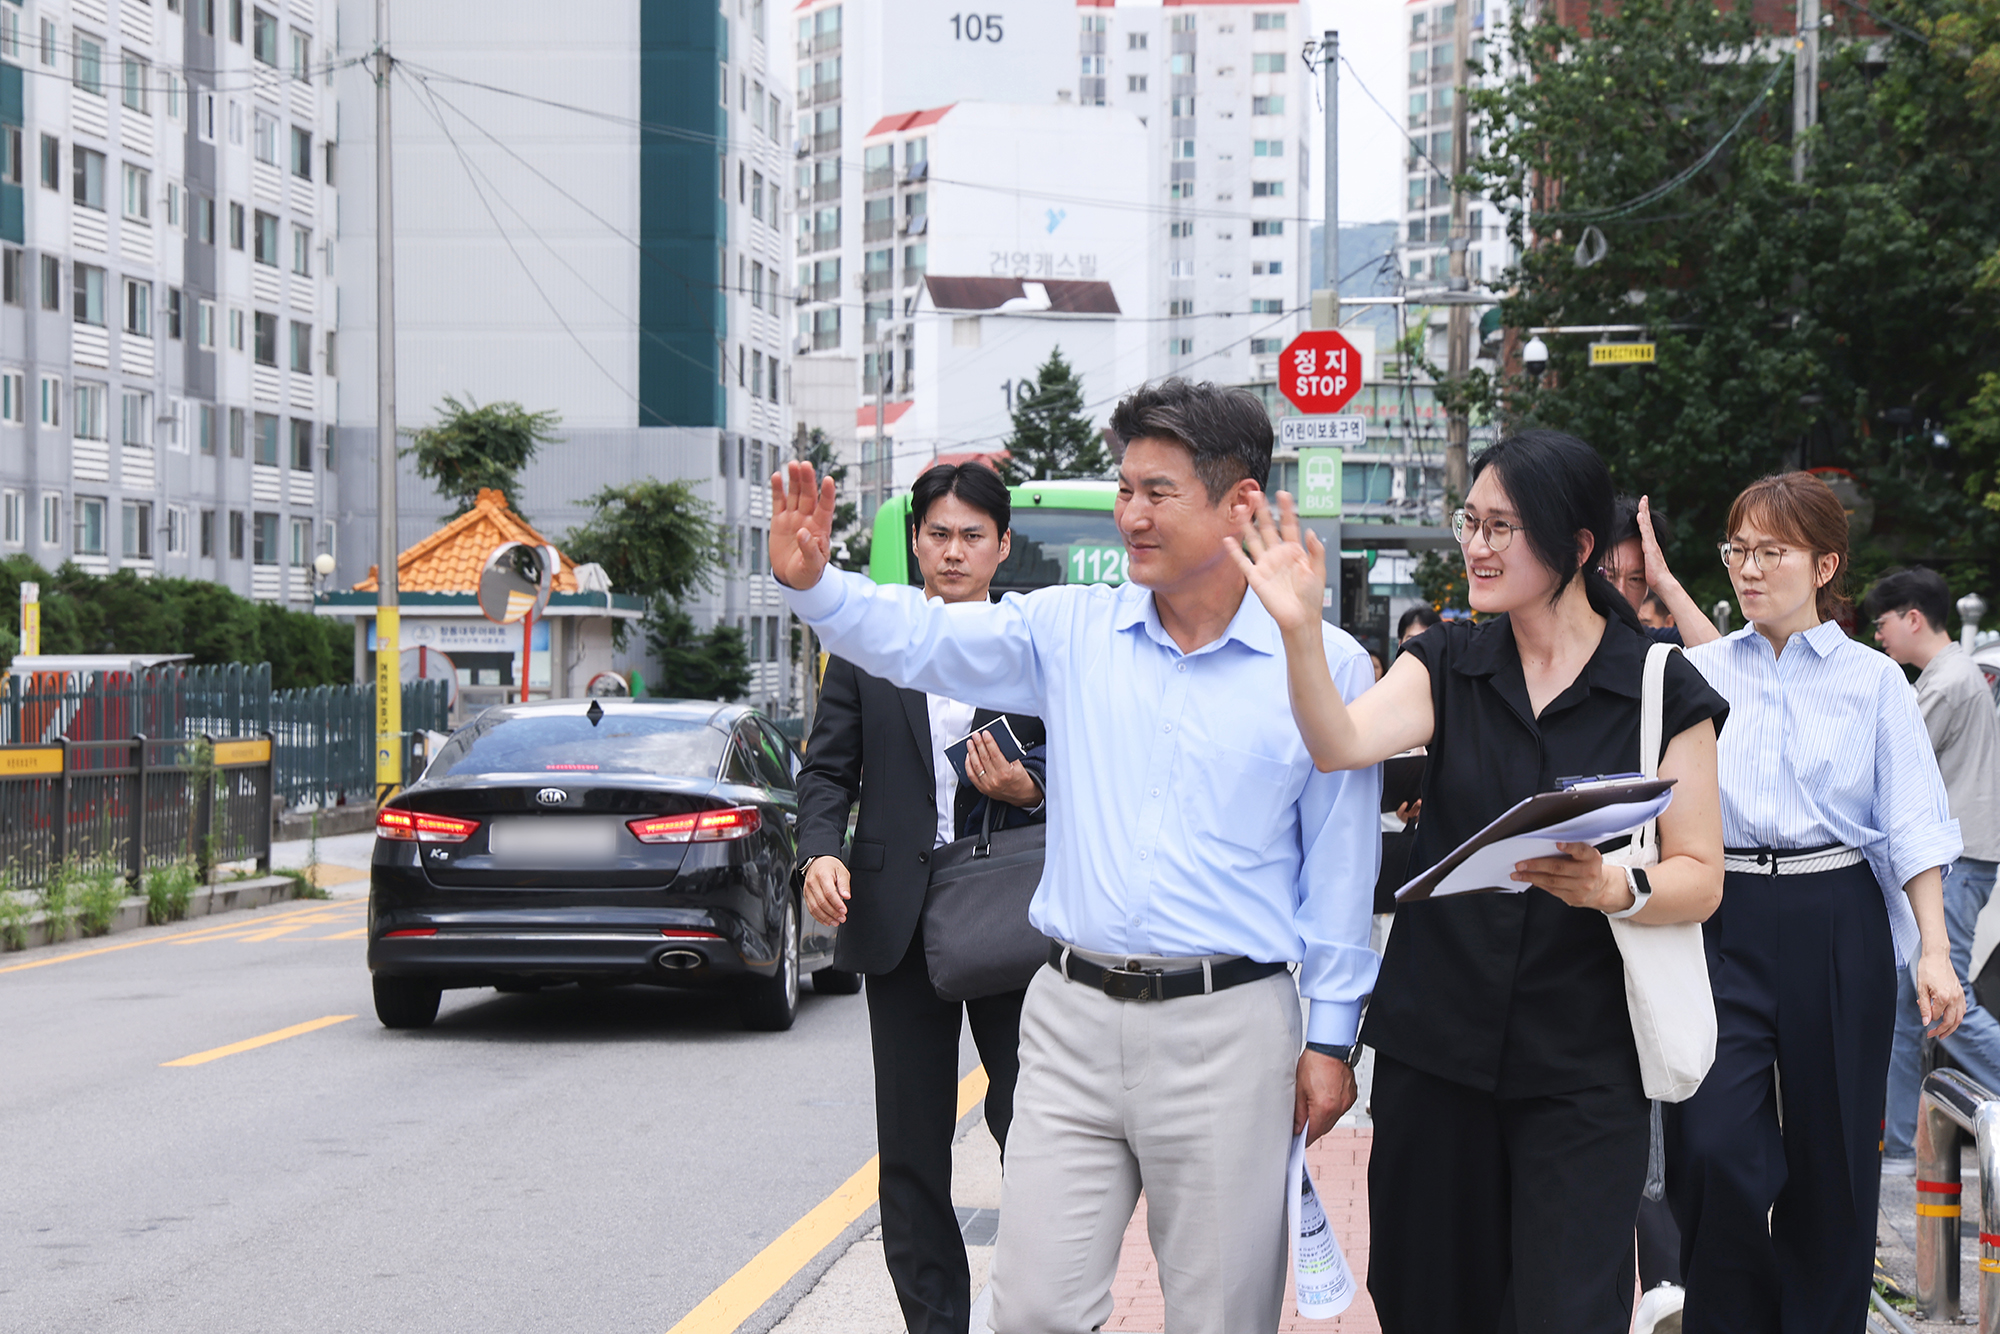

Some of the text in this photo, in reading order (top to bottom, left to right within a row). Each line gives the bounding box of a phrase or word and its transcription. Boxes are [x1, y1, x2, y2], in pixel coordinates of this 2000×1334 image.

[950, 12, 1003, 43] 105
[989, 251, 1097, 277] 건영캐스빌
[1296, 375, 1347, 396] STOP
[1285, 421, 1360, 440] 어린이보호구역
[1306, 494, 1334, 509] BUS
[540, 790, 562, 803] KIA
